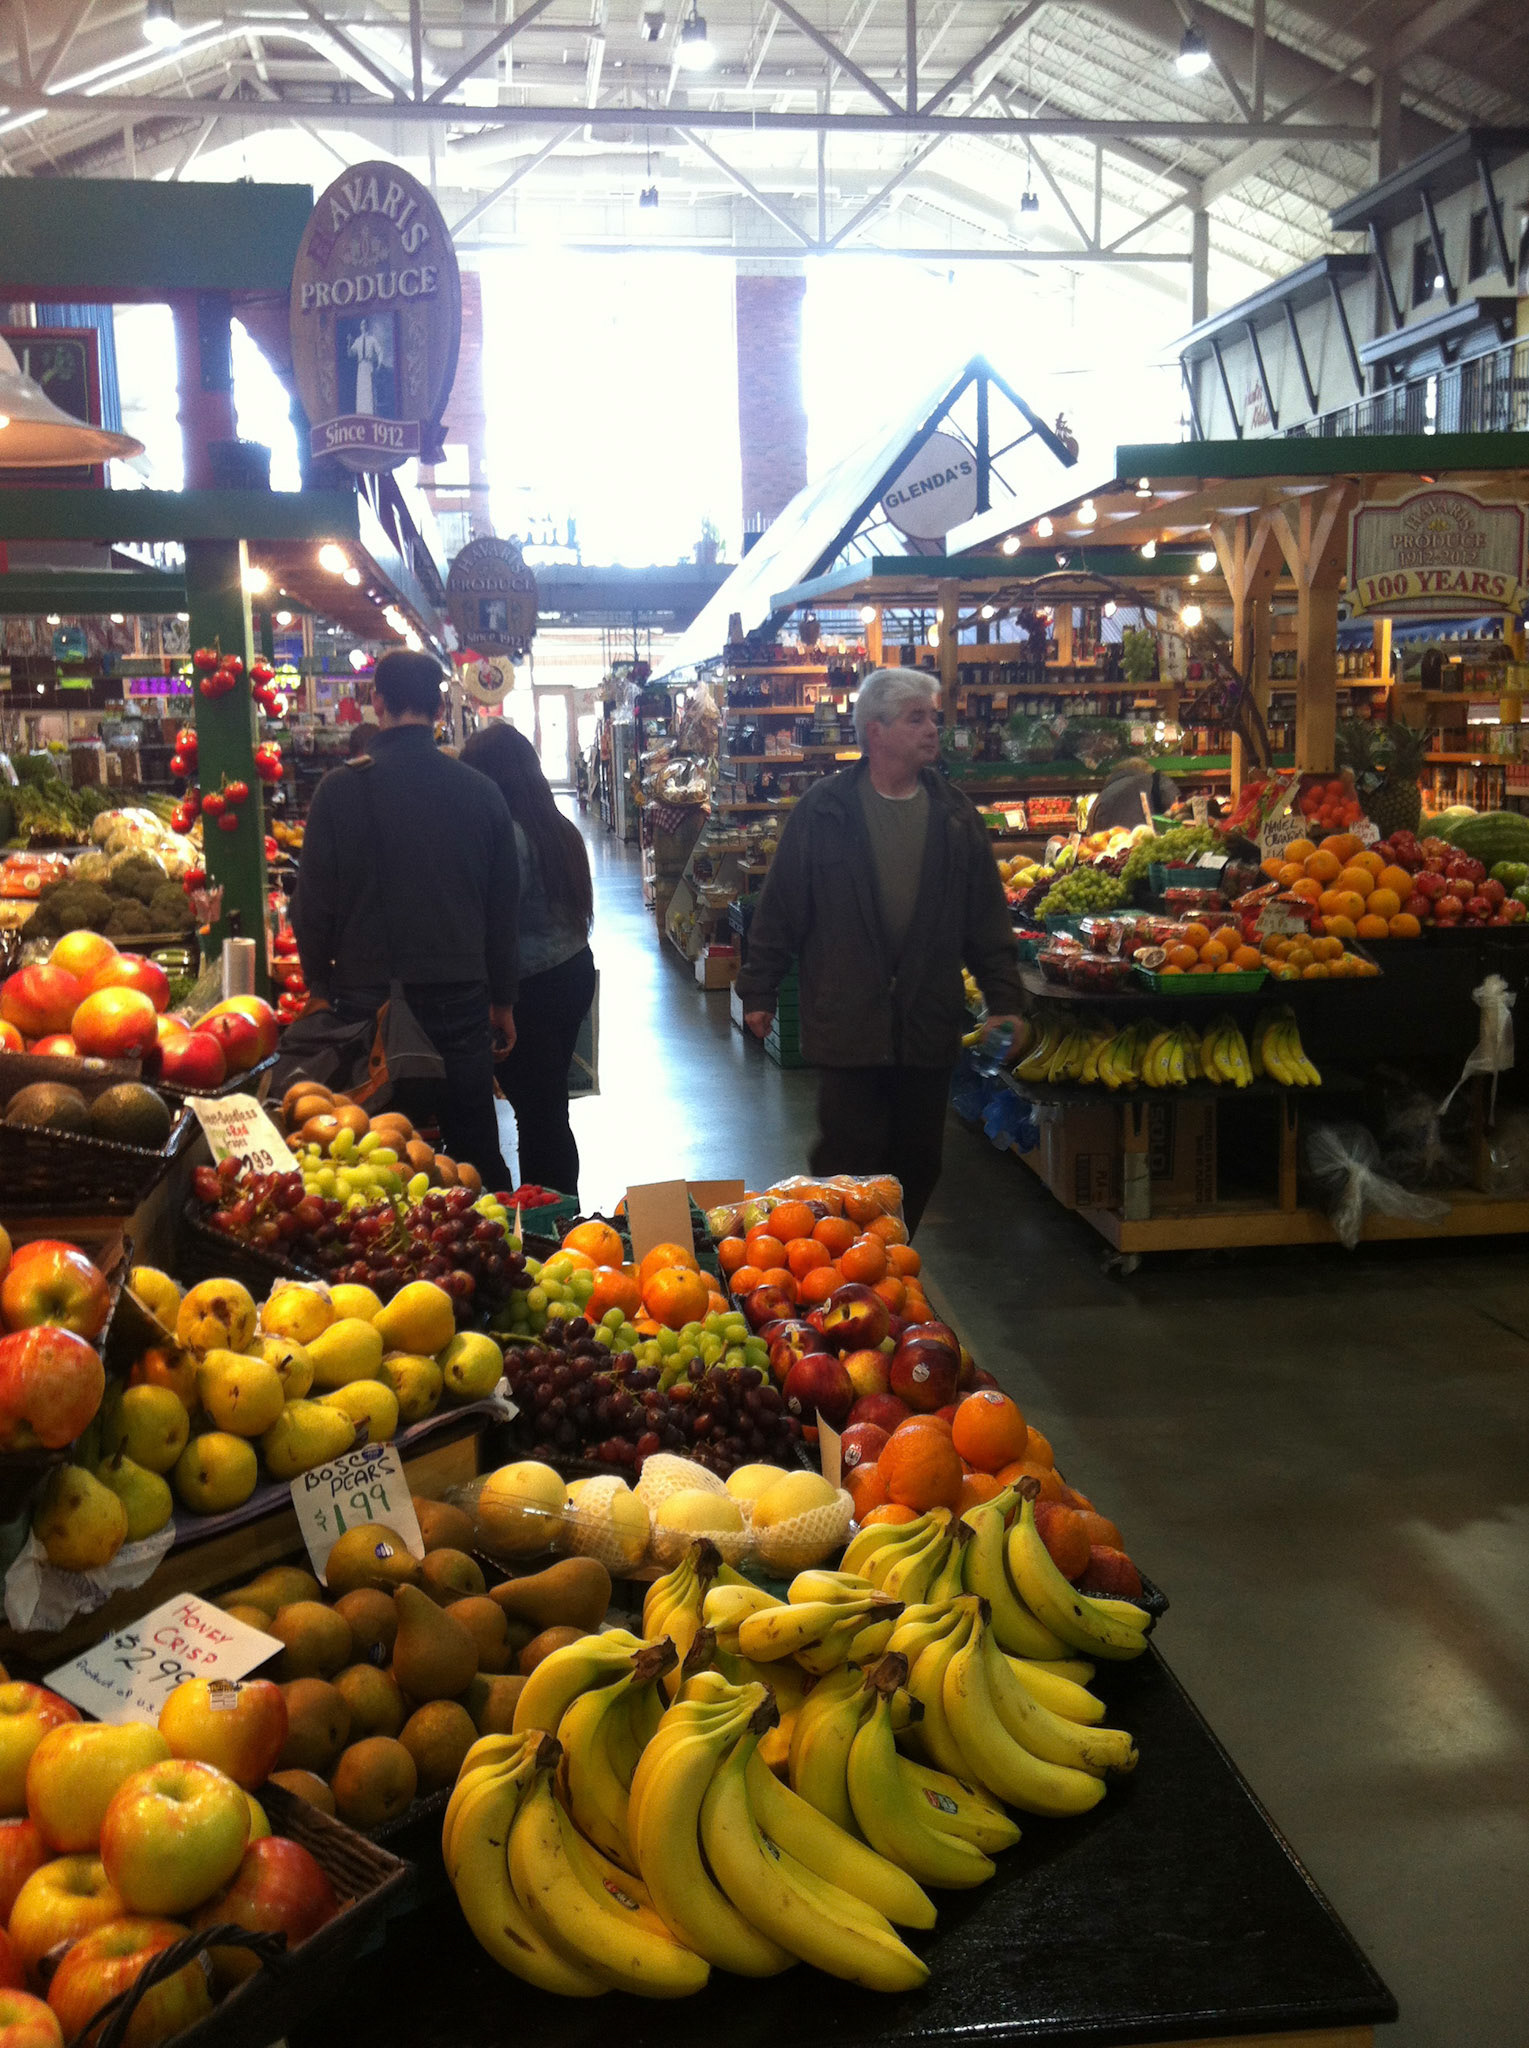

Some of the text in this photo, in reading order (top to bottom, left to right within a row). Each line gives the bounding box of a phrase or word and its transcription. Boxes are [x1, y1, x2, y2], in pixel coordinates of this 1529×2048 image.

[301, 265, 438, 309] PRODUCE
[326, 422, 404, 448] Since 1912
[885, 460, 973, 508] GLENDA'S
[1392, 533, 1487, 548] PRODUCE
[451, 579, 534, 593] PRODUCE
[1366, 570, 1507, 601] 100 YEARS
[304, 1455, 370, 1492] BOSC
[330, 1456, 396, 1498] PEARS
[172, 1600, 235, 1645] HONEY
[153, 1626, 218, 1665] CRISP
